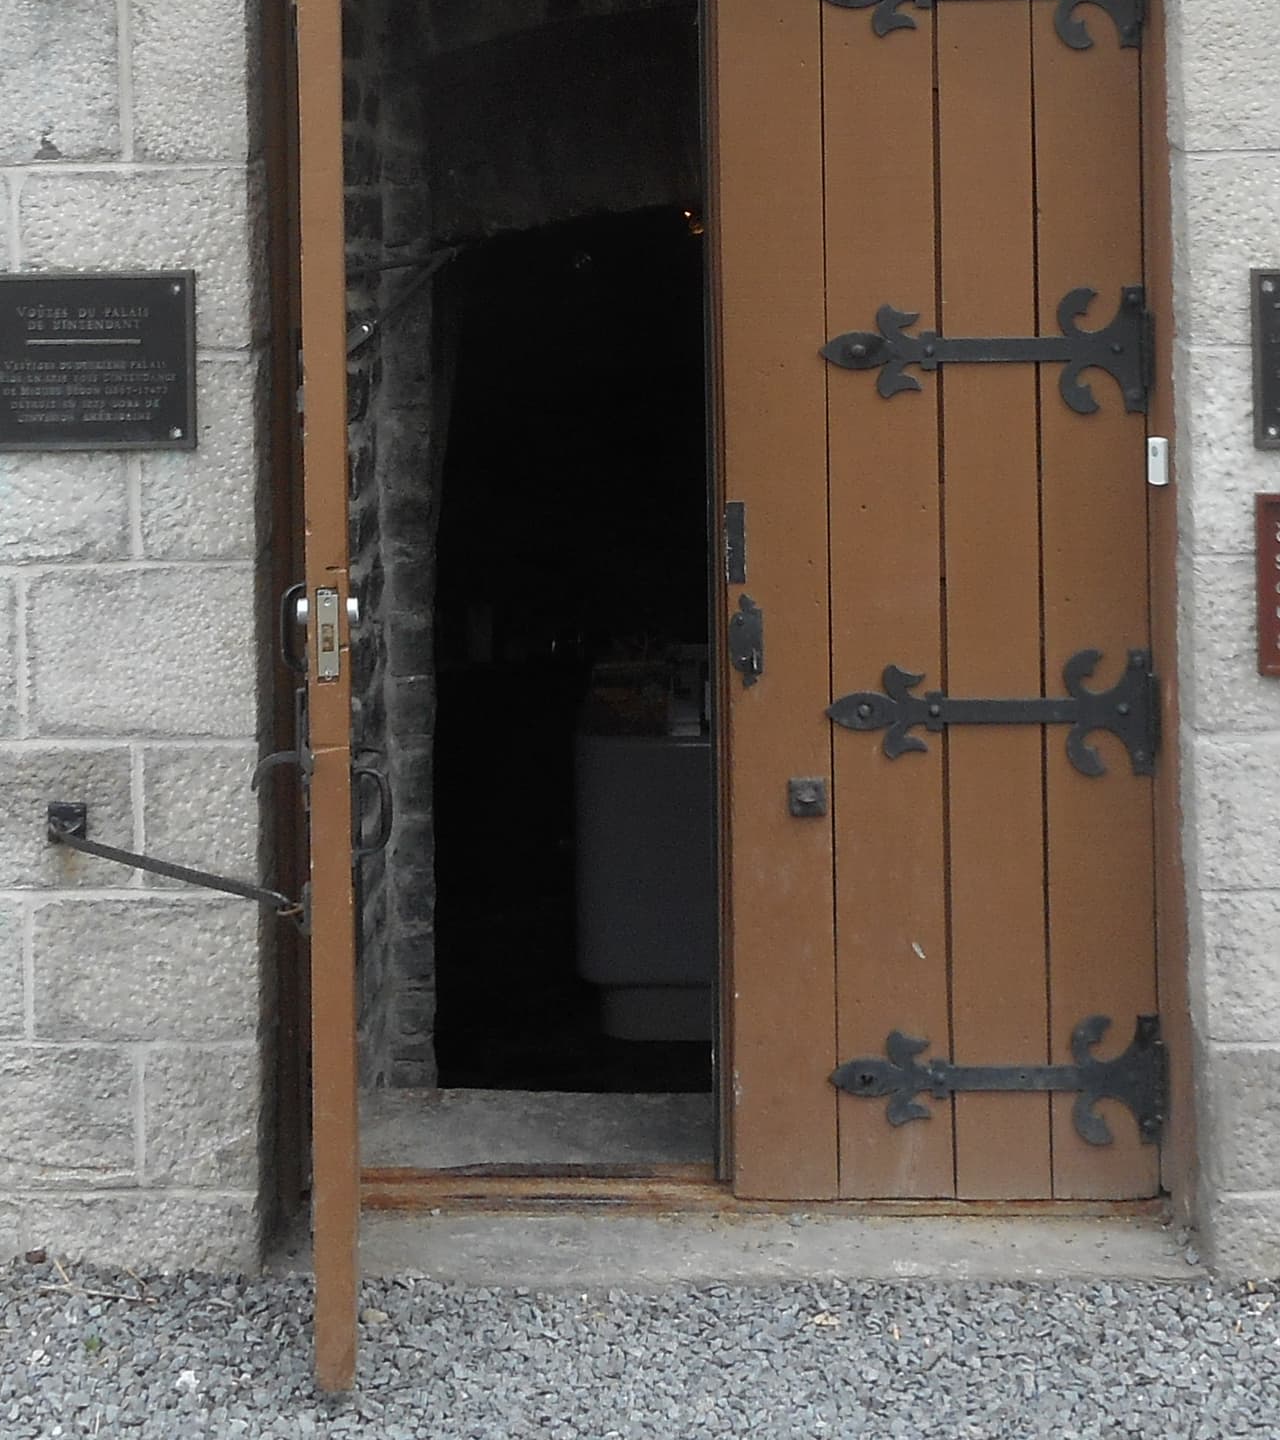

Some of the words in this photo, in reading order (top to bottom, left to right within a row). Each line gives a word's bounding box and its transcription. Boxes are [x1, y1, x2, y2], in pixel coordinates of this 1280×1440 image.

[78, 307, 96, 318] DU
[104, 306, 150, 318] PALAIS
[27, 320, 44, 330] DE
